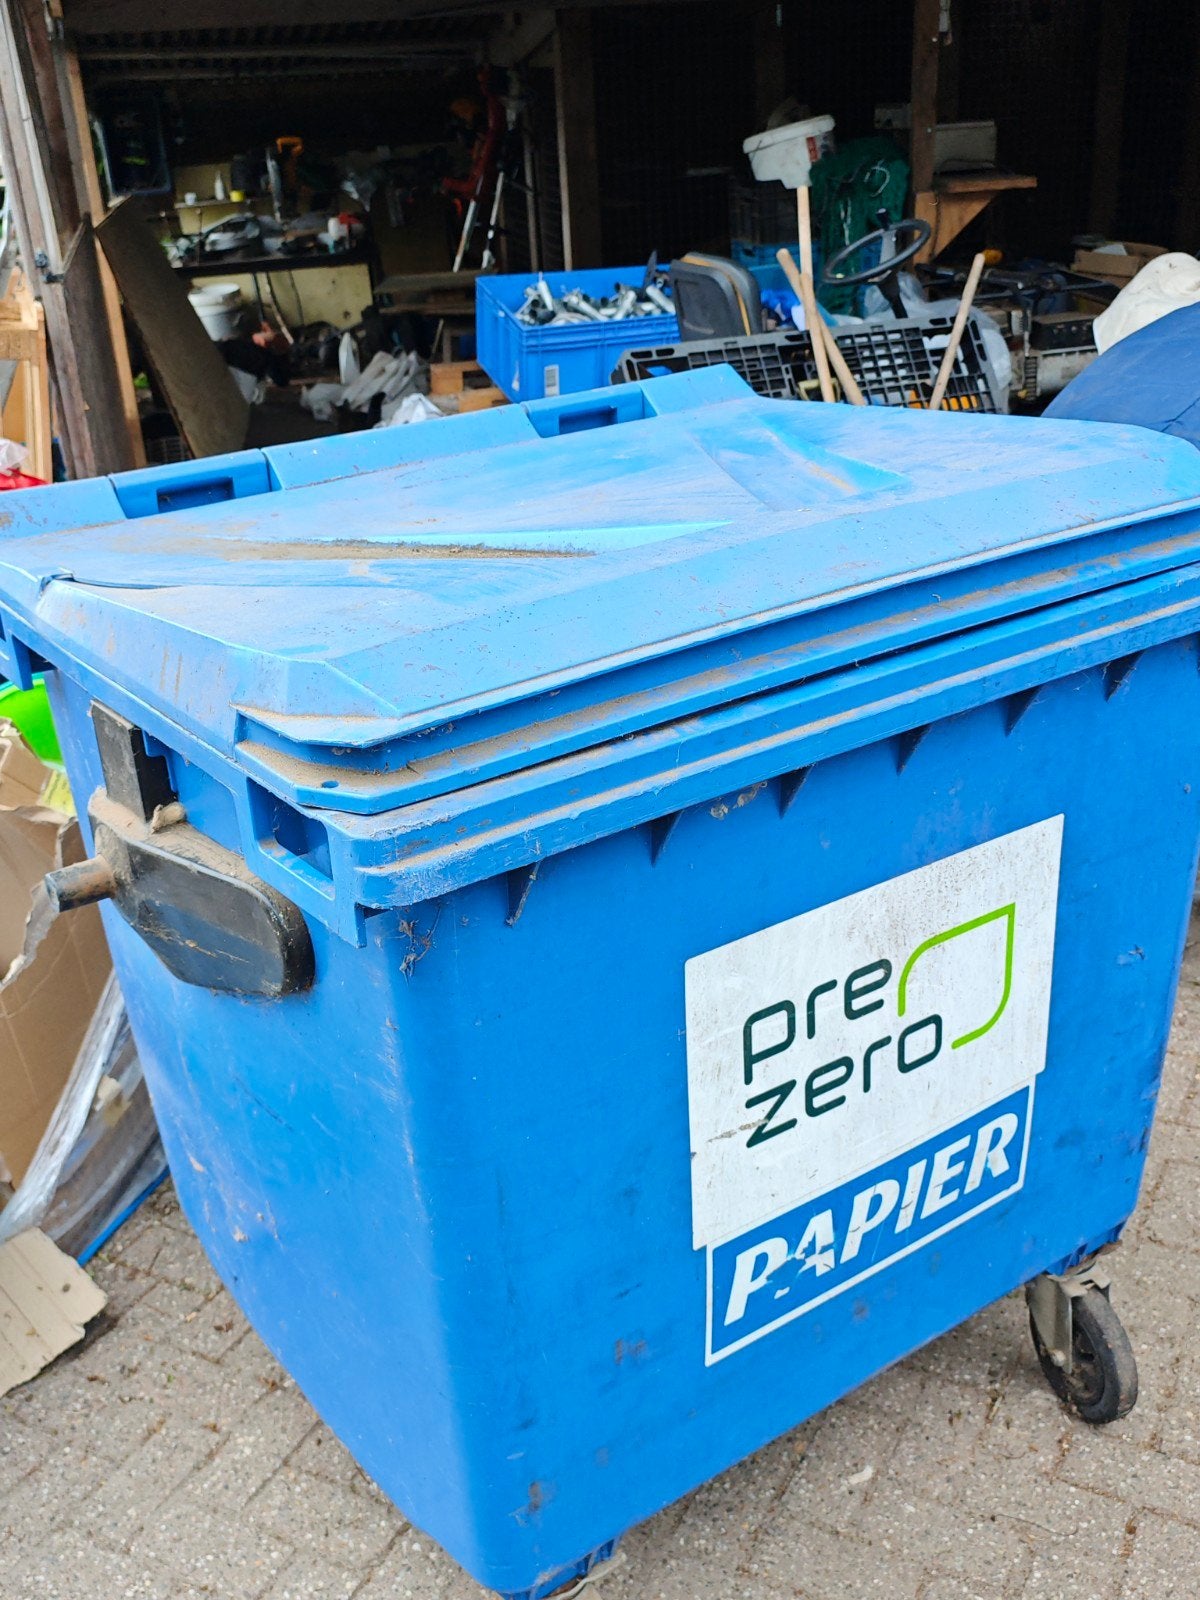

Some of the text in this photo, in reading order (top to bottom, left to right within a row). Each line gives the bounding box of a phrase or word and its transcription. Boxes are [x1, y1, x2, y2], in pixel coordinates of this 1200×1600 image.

[744, 958, 892, 1085] pre
[745, 1014, 942, 1148] zero
[724, 1112, 1018, 1325] PAPIER
